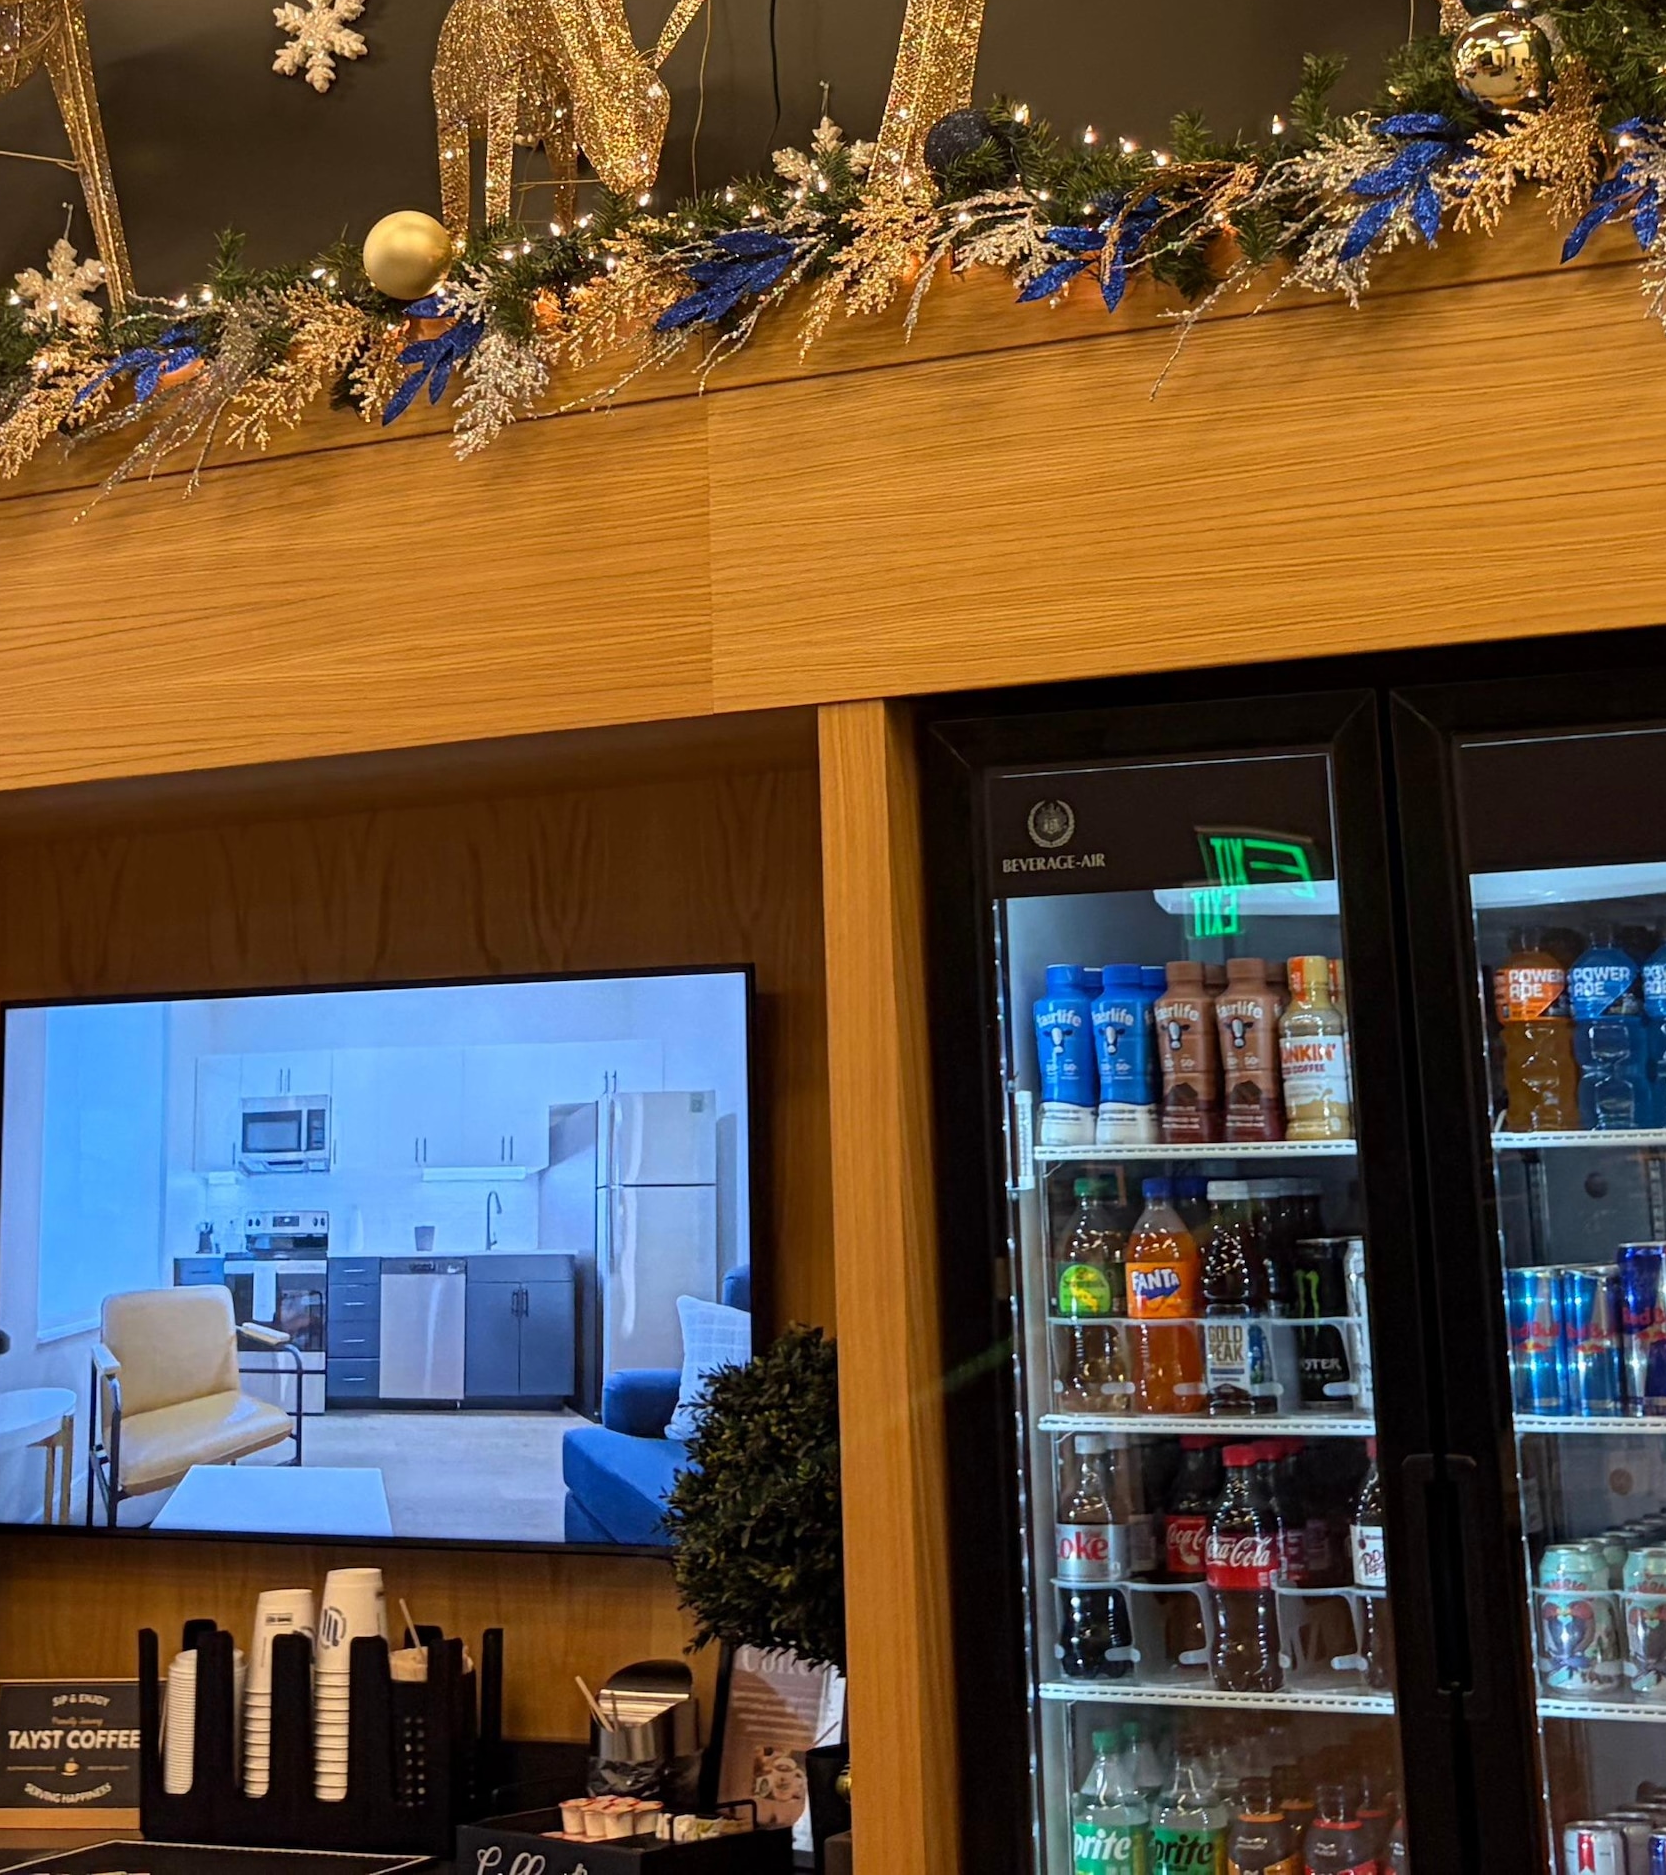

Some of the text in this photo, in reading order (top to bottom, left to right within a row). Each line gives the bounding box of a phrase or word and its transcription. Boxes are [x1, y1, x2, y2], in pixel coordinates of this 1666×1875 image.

[1002, 853, 1106, 874] BEVERAGE-AIR
[1508, 969, 1565, 983] POWER
[1573, 966, 1631, 982] POWER
[1131, 1268, 1180, 1292] FANTA
[1208, 1325, 1244, 1343] GOLD
[1209, 1342, 1245, 1362] PEAK
[1058, 1531, 1110, 1562] oke
[52, 1694, 68, 1707] SIP
[7, 1729, 142, 1750] TAYST COFFEE
[61, 1782, 113, 1804] HAPPINESS
